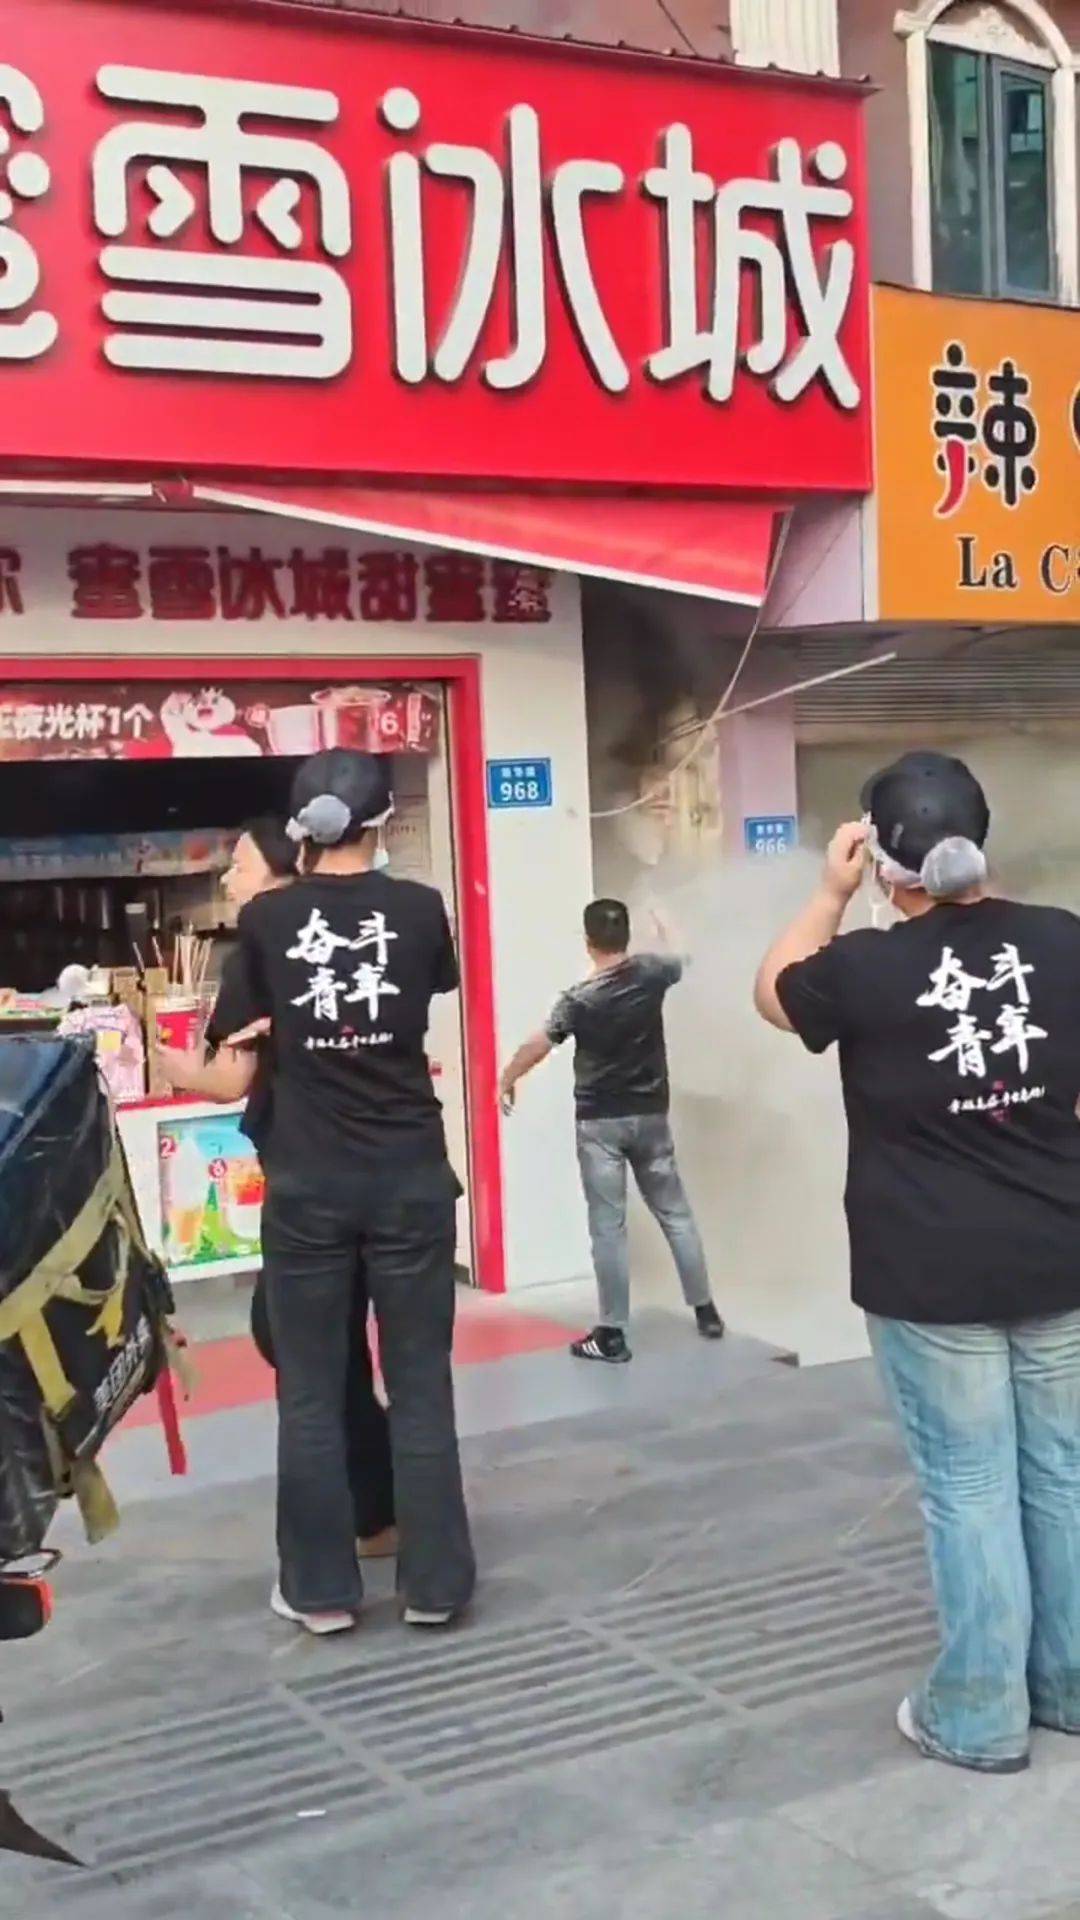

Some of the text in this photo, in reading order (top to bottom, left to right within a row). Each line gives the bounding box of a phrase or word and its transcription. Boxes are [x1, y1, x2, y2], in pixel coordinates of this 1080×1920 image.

[0, 63, 860, 409] 雪冰城
[958, 536, 1080, 594] La C
[500, 781, 539, 802] 968
[755, 837, 786, 856] 966
[285, 907, 399, 965] 奋斗
[290, 961, 400, 1021] 青年
[915, 942, 1035, 1011] 奋斗
[927, 1003, 1048, 1078] 青年
